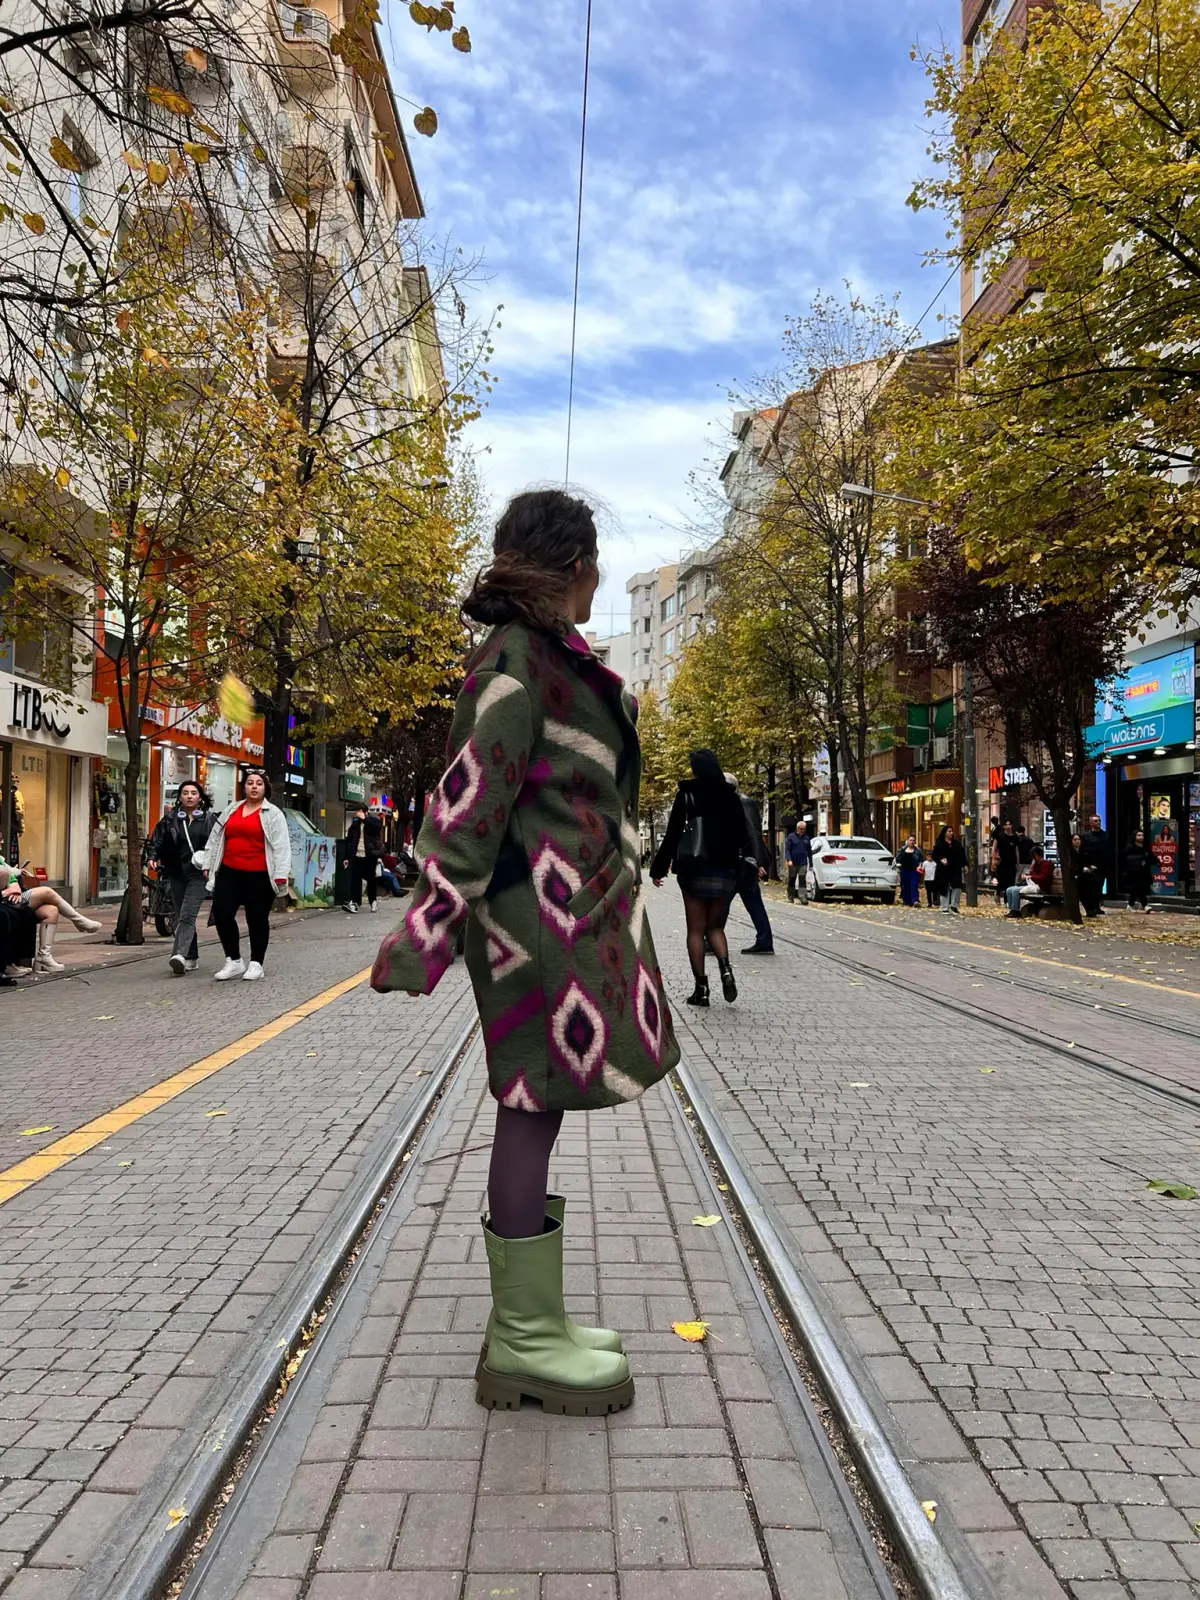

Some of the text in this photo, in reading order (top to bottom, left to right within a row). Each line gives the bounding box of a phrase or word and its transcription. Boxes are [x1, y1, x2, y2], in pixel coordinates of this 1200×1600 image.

[12, 682, 42, 732] LTB
[1110, 722, 1156, 744] watsons
[21, 755, 45, 773] LTB
[989, 766, 1033, 791] IN STREE
